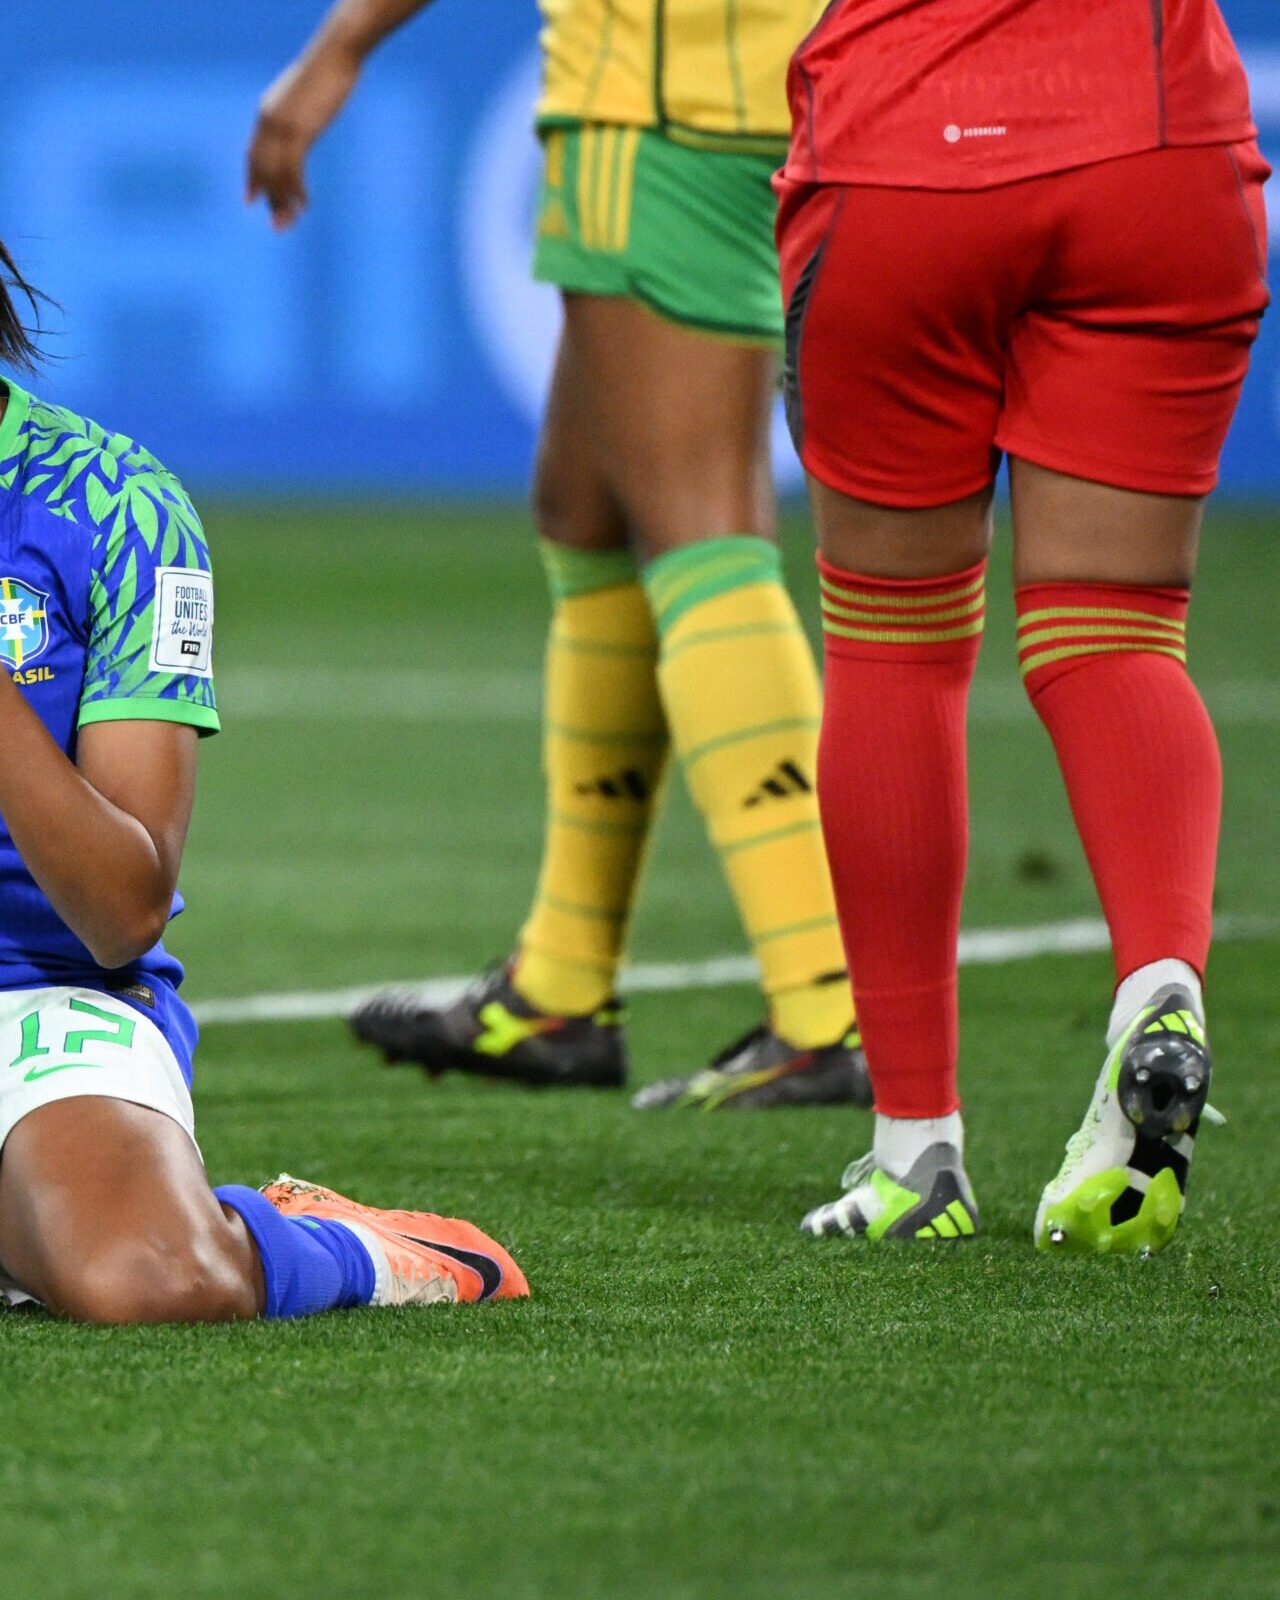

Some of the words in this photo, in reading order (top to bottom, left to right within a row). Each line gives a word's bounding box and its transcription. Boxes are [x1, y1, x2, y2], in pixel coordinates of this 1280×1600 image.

[175, 586, 208, 602] FOOTBALL
[0, 613, 26, 625] CBF
[175, 601, 208, 621] UNITES
[170, 619, 187, 636] the
[12, 666, 55, 685] ASIL
[9, 997, 136, 1067] 17
